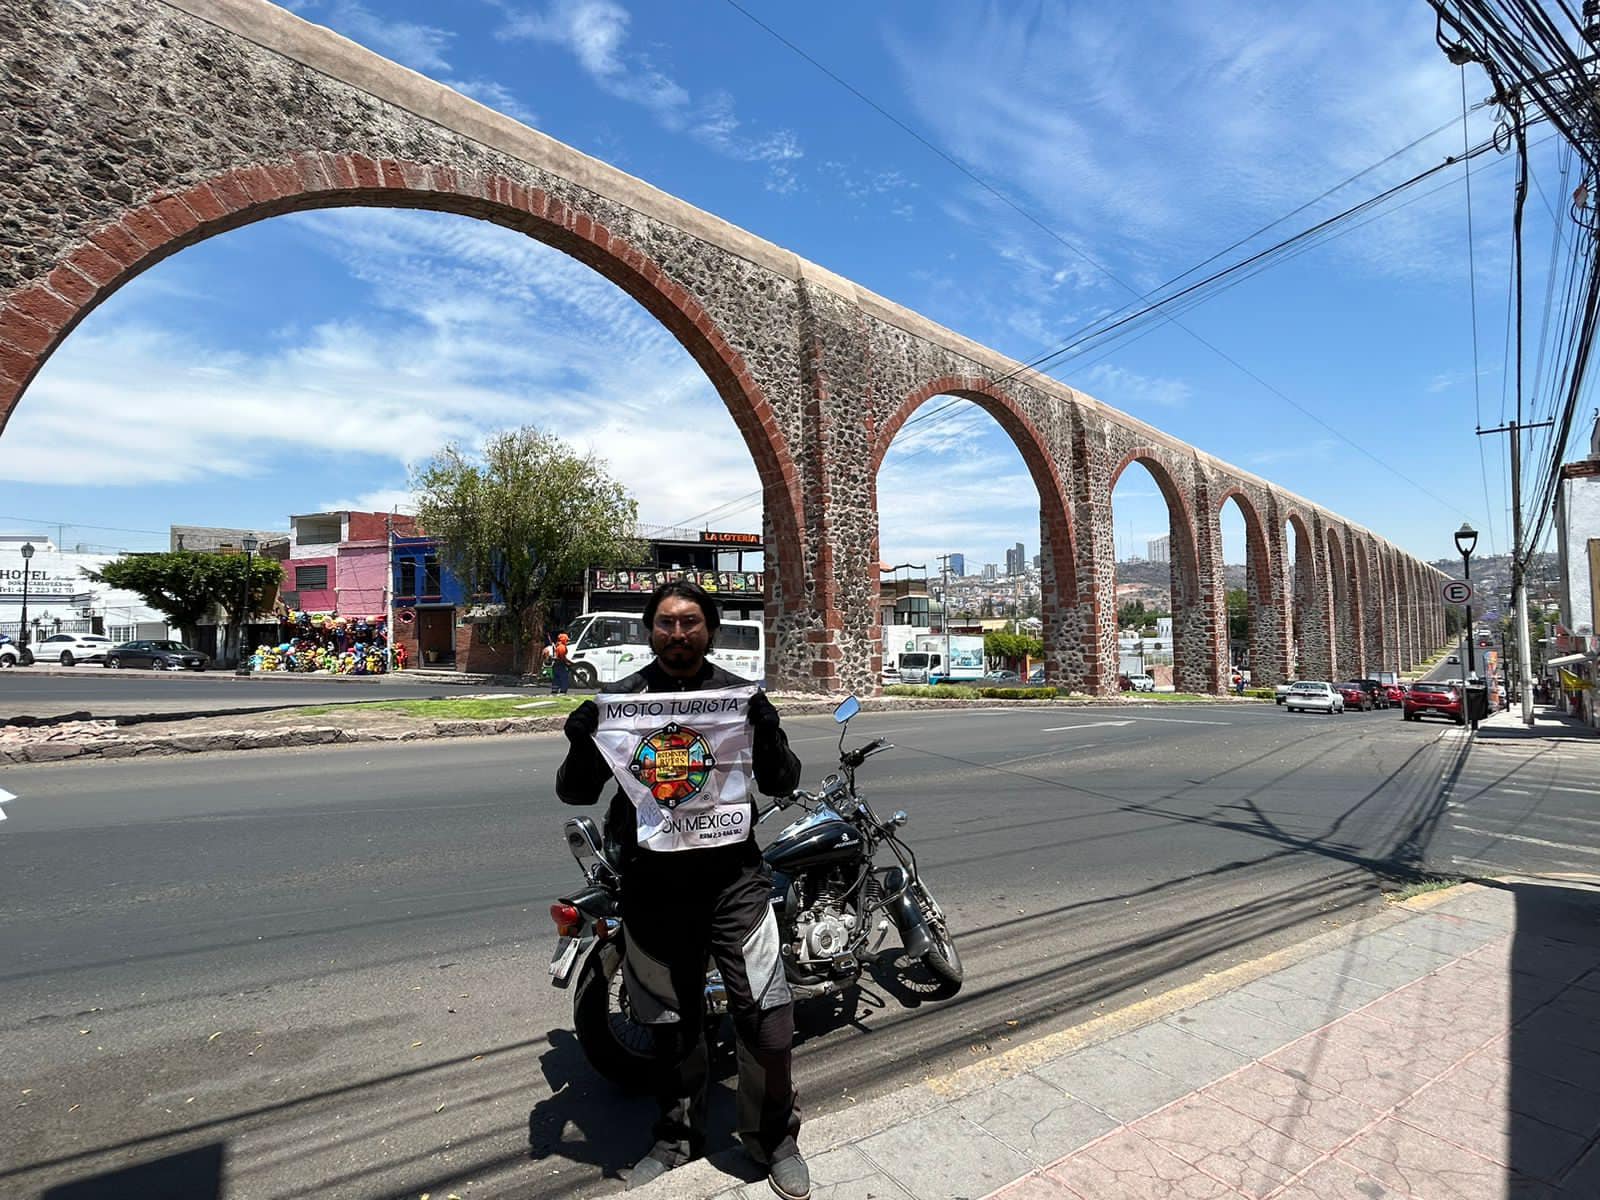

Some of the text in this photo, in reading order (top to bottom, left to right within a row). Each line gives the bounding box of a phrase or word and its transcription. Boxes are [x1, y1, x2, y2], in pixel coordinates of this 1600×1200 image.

[704, 533, 718, 541] LA
[1450, 586, 1465, 599] E
[606, 698, 739, 719] MOTO TURISTA
[685, 811, 744, 832] MÉXICO
